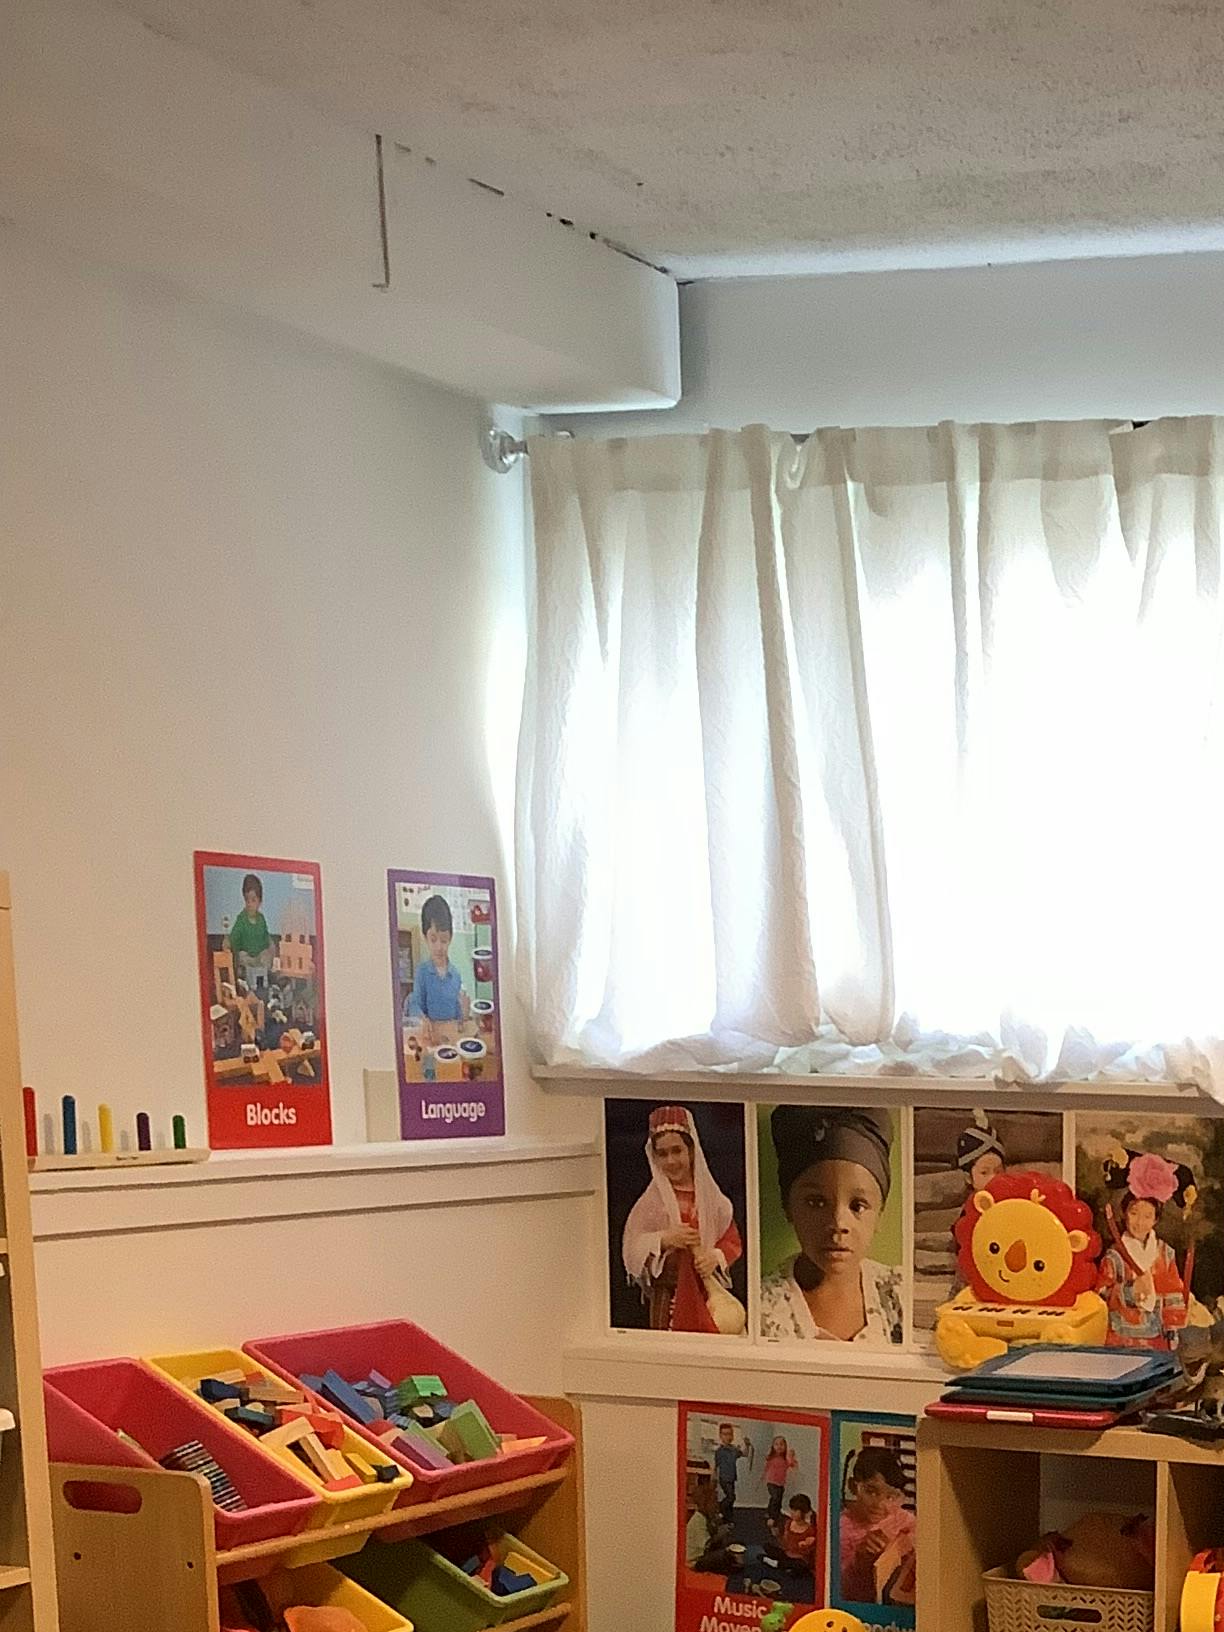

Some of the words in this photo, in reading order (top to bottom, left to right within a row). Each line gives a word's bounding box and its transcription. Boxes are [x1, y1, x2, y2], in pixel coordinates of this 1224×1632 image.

[246, 1102, 297, 1126] Blocks
[421, 1100, 486, 1123] Language
[714, 1596, 767, 1616] Music
